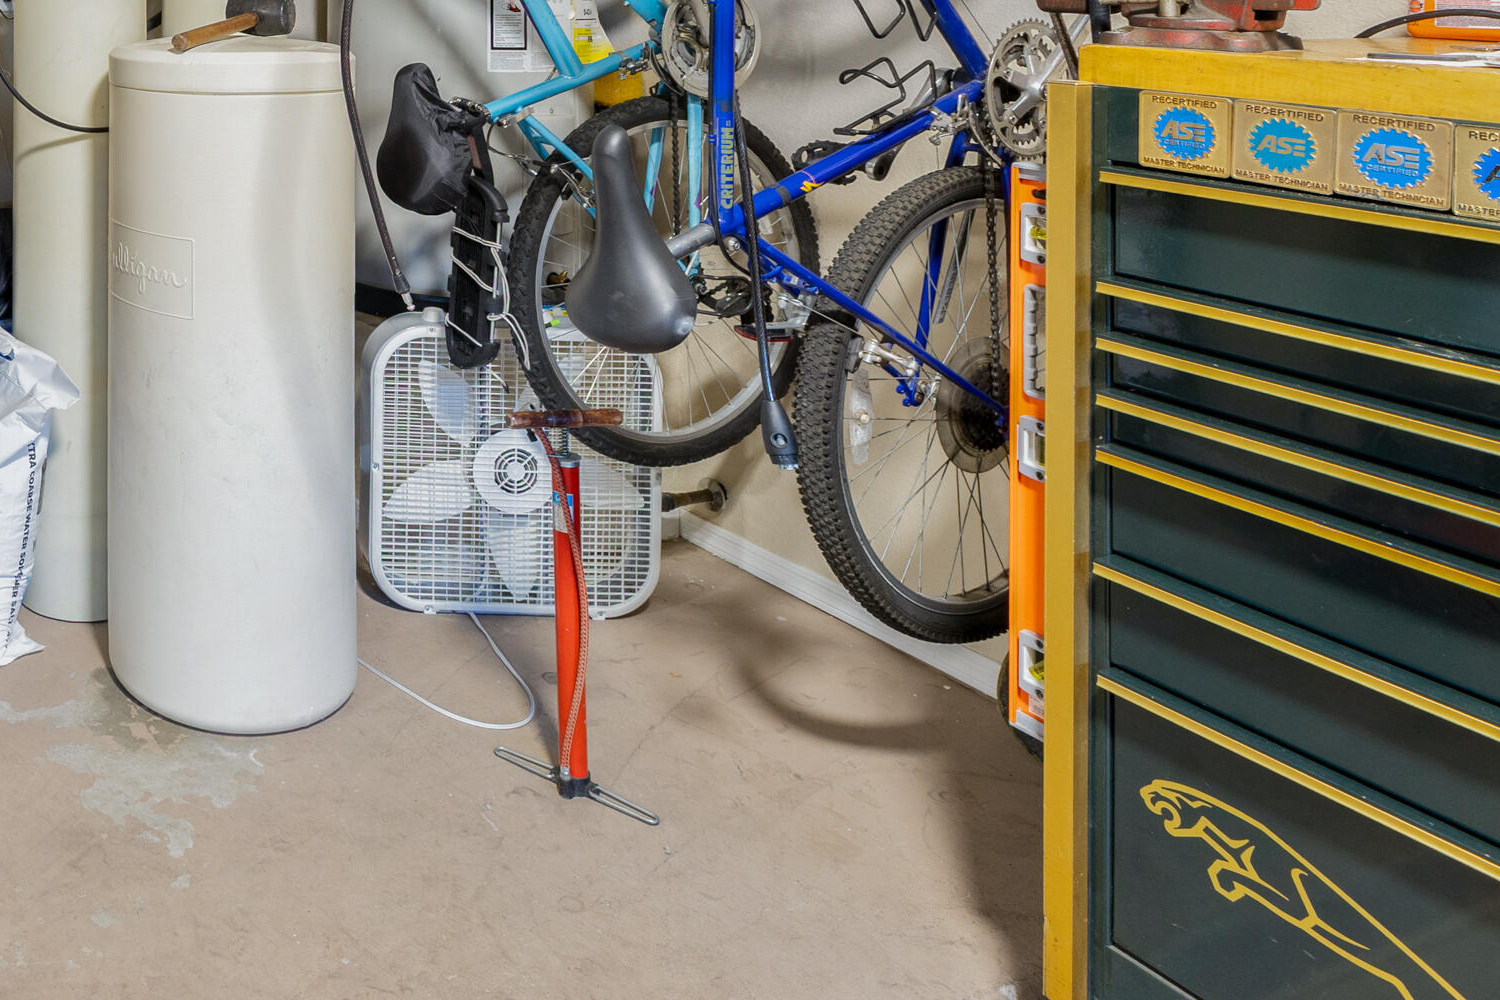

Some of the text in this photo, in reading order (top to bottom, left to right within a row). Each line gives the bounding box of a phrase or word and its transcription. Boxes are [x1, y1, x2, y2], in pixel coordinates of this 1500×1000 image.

[1151, 95, 1218, 109] RECERTIFIED
[1245, 104, 1325, 122] RECERTIFIED
[1160, 119, 1206, 142] ASE
[1352, 114, 1436, 132] RECERTIFIED
[1163, 138, 1206, 149] CERTIFIED
[1256, 134, 1306, 158] ASE
[1143, 157, 1226, 175] MASTER TECHNICIAN
[1361, 142, 1421, 170] ASE
[720, 127, 735, 210] CRITERIUM
[1366, 164, 1419, 177] CERTIFIED
[1235, 169, 1328, 191] MASTER TECHNICIAN
[1339, 183, 1445, 206] MASTER TECHNICIAN
[111, 241, 187, 295] ulligan
[21, 512, 32, 552] WATER
